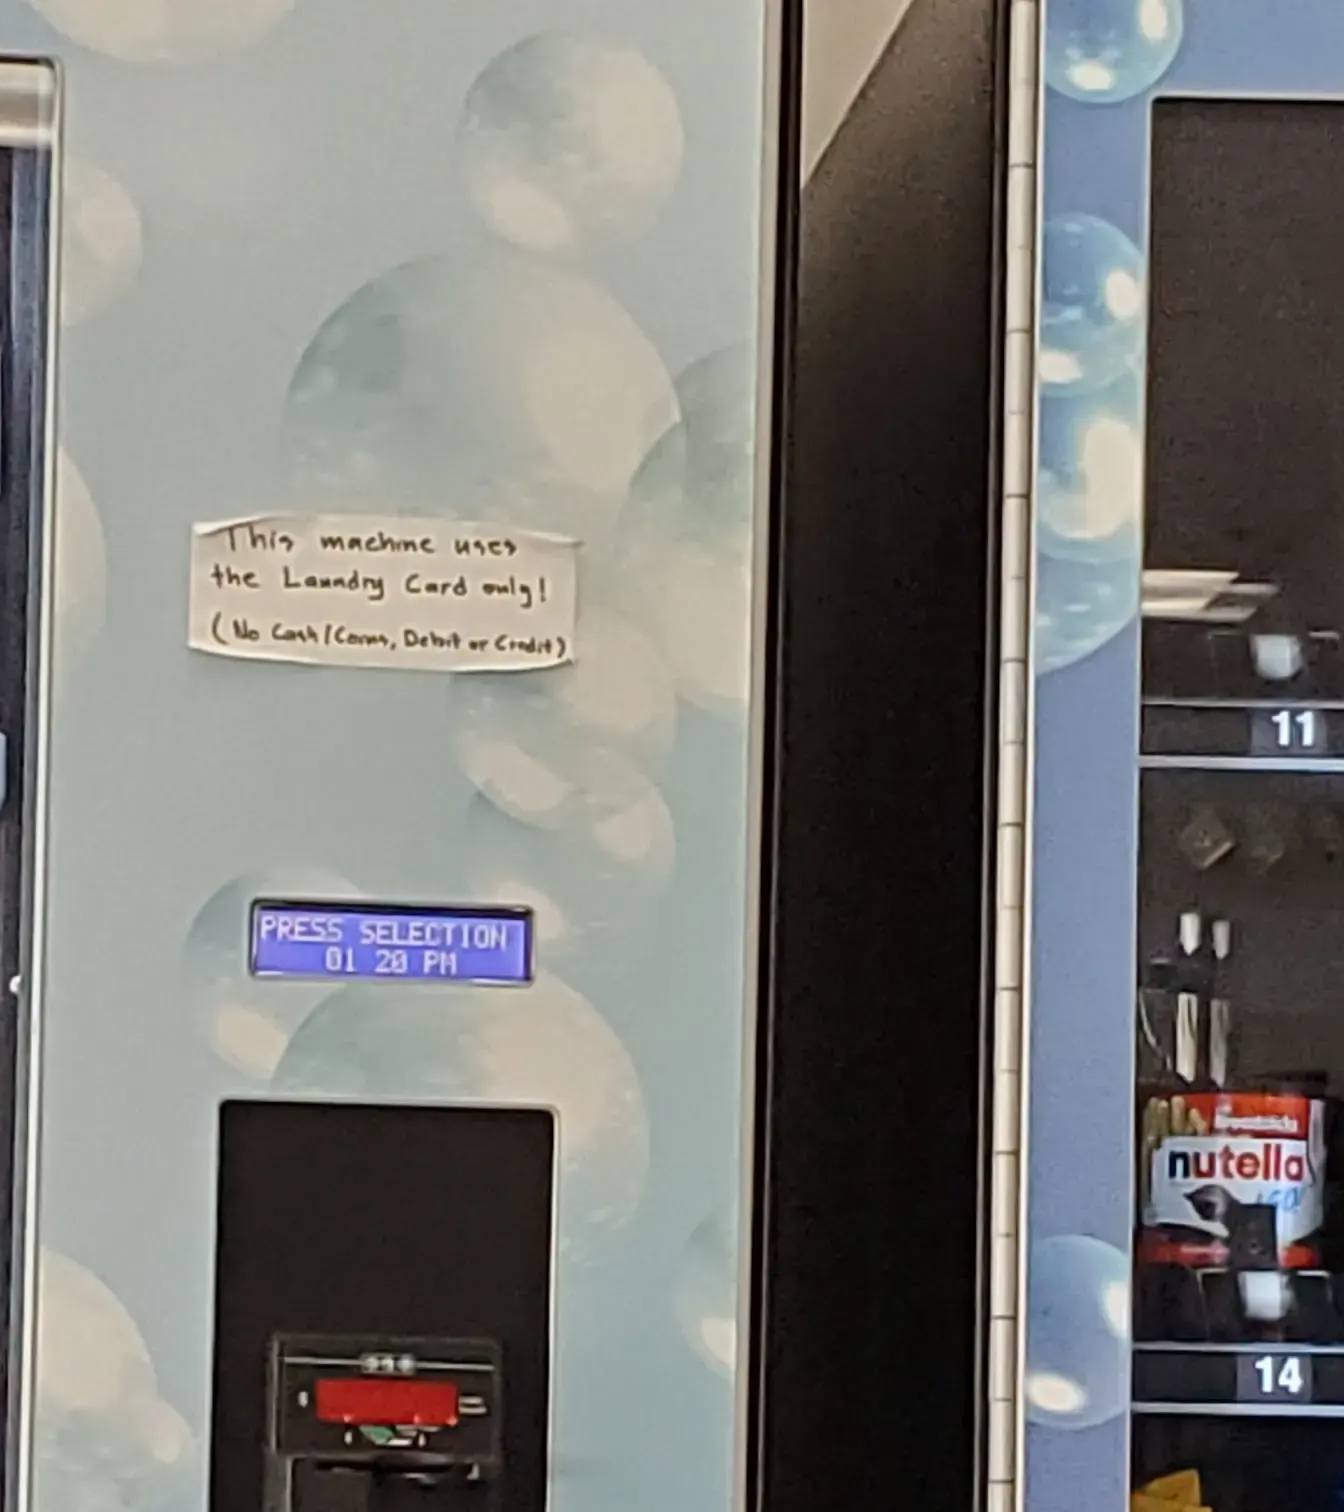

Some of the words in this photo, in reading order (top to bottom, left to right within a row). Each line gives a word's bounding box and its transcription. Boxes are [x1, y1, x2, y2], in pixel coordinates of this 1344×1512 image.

[226, 525, 295, 554] This
[320, 531, 436, 555] machine
[455, 537, 518, 558] uses
[210, 563, 261, 589] the
[283, 565, 385, 601] Laundry
[404, 571, 468, 597] Card
[482, 577, 548, 609] only!
[404, 629, 461, 651] Debit
[467, 637, 489, 652] or
[1273, 710, 1316, 748] 11
[259, 914, 345, 942] PRESS
[359, 919, 507, 951] SELECTION
[423, 951, 457, 976] PM
[1167, 1142, 1305, 1182] nutella
[1255, 1356, 1303, 1394] 14
